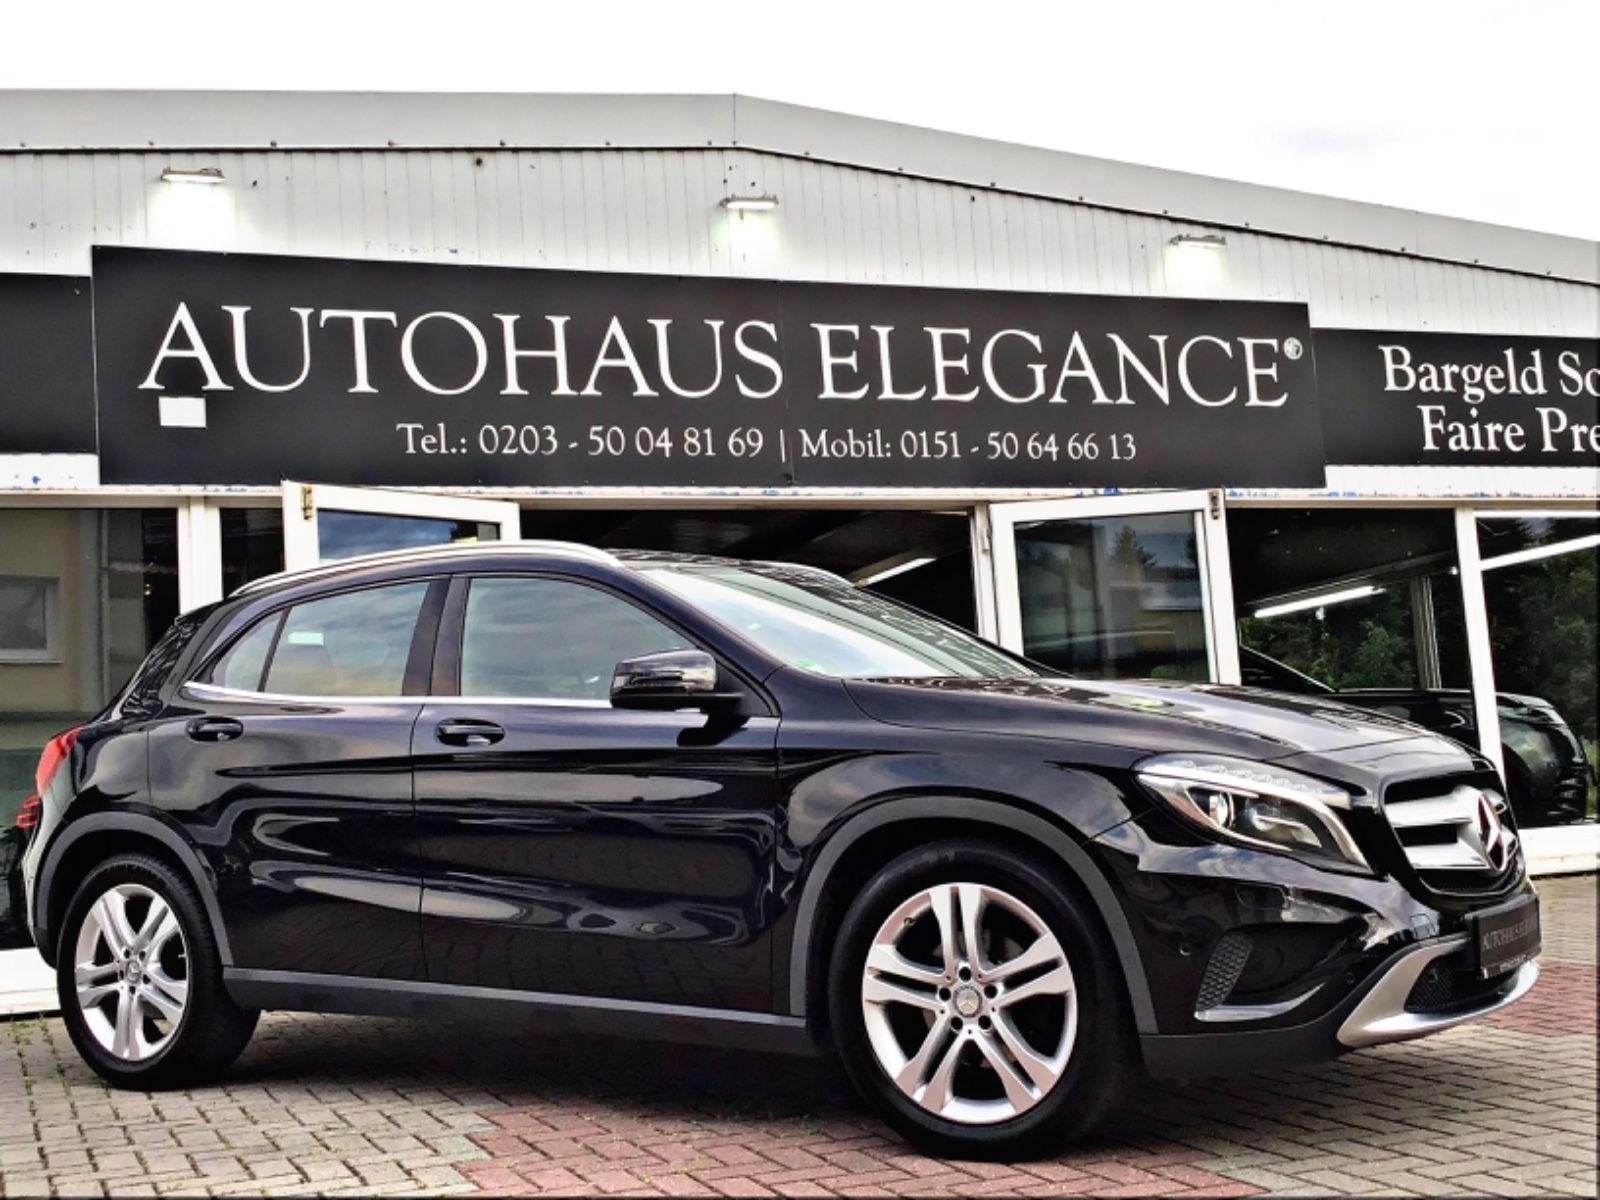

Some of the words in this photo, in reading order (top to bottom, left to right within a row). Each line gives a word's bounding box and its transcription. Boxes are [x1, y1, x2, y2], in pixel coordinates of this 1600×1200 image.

[138, 302, 783, 399] AUTOHAUS
[810, 323, 1288, 407] ELEGANCE
[1379, 345, 1547, 404] Bargeld
[396, 423, 467, 454] Tel.:
[479, 424, 558, 455] 0203
[589, 425, 625, 456] 50
[635, 427, 674, 458] 04
[684, 427, 717, 456] 81
[728, 427, 764, 458] 69
[798, 428, 891, 458] Mobil:
[900, 430, 961, 459] 0151
[988, 432, 1018, 459] 50
[1027, 432, 1060, 461] 64
[1068, 433, 1099, 460] 66
[1110, 433, 1136, 460] 13
[1417, 405, 1525, 451] Faire
